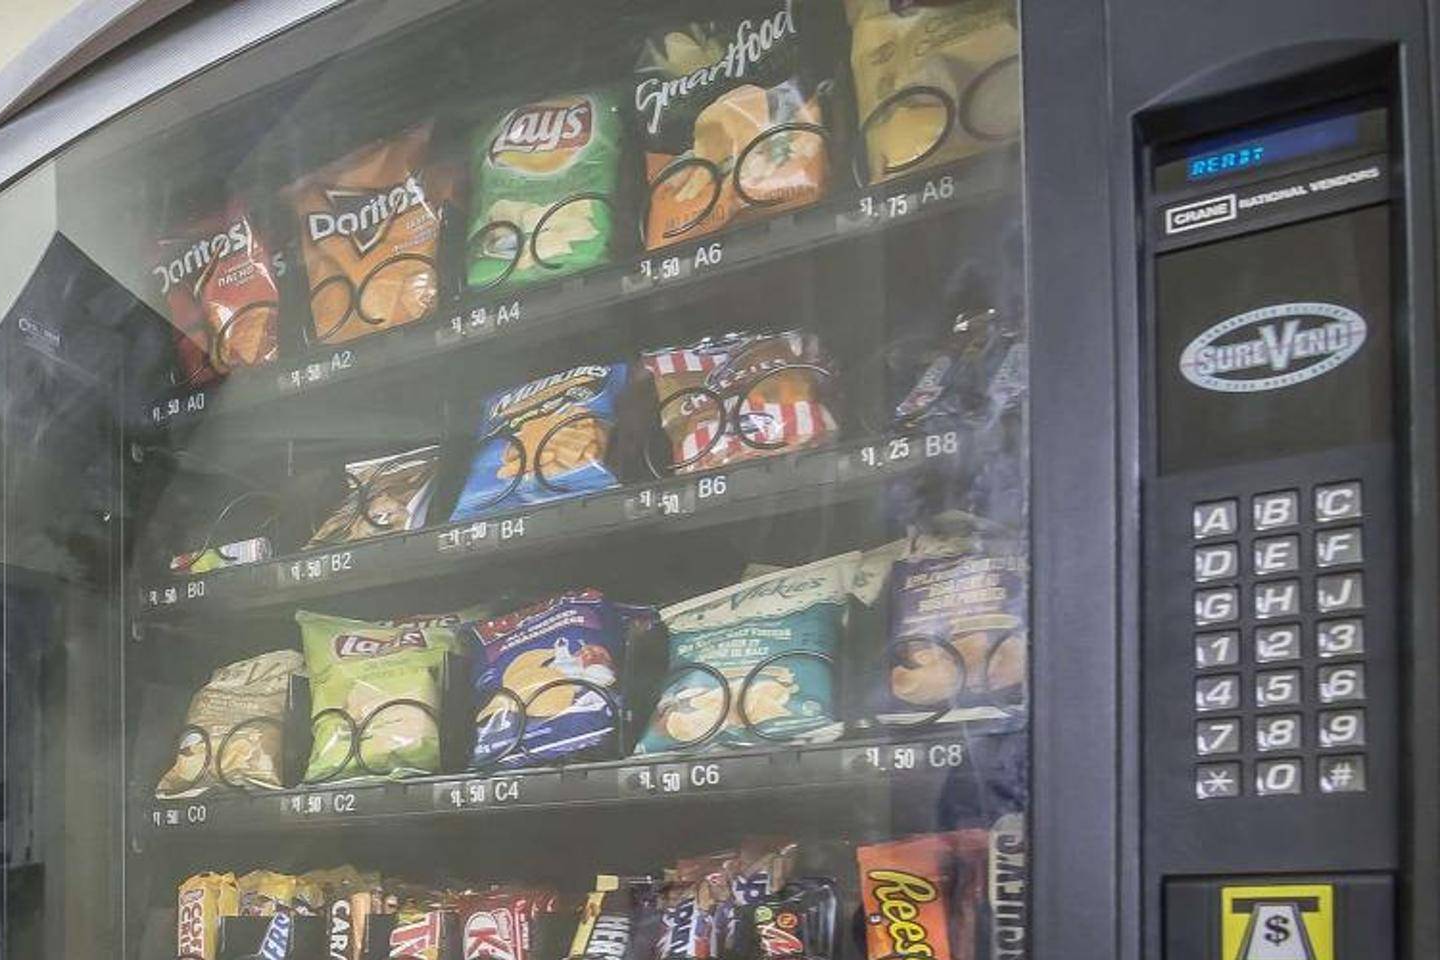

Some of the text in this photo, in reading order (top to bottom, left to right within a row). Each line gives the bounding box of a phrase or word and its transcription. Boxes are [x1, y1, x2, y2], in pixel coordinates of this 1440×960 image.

[635, 3, 796, 134] Smartfood
[492, 103, 589, 153] Lay's
[923, 177, 954, 204] A8
[1238, 167, 1381, 208] NATIONAL VENDORS
[309, 172, 426, 240] Doritos
[1174, 203, 1229, 226] CRANE
[694, 243, 722, 269] A6
[497, 302, 520, 325] A4
[330, 351, 353, 372] A2
[187, 395, 205, 412] A0
[925, 432, 957, 458] B8
[698, 475, 727, 498] B6
[1202, 489, 1353, 533] A B C
[501, 518, 525, 539] B4
[331, 553, 352, 572] B2
[1202, 534, 1352, 576] D E F
[187, 580, 205, 599] B0
[1205, 579, 1352, 619] G H J
[1211, 625, 1355, 661] 1 2 3
[1207, 670, 1356, 705] 4 5 6
[1209, 715, 1357, 750] 7 8 9
[928, 742, 962, 768] C8
[691, 765, 719, 786] C6
[1267, 763, 1356, 790] 0 #
[334, 793, 355, 813] C2
[495, 779, 519, 801] C4
[187, 806, 206, 823] C0
